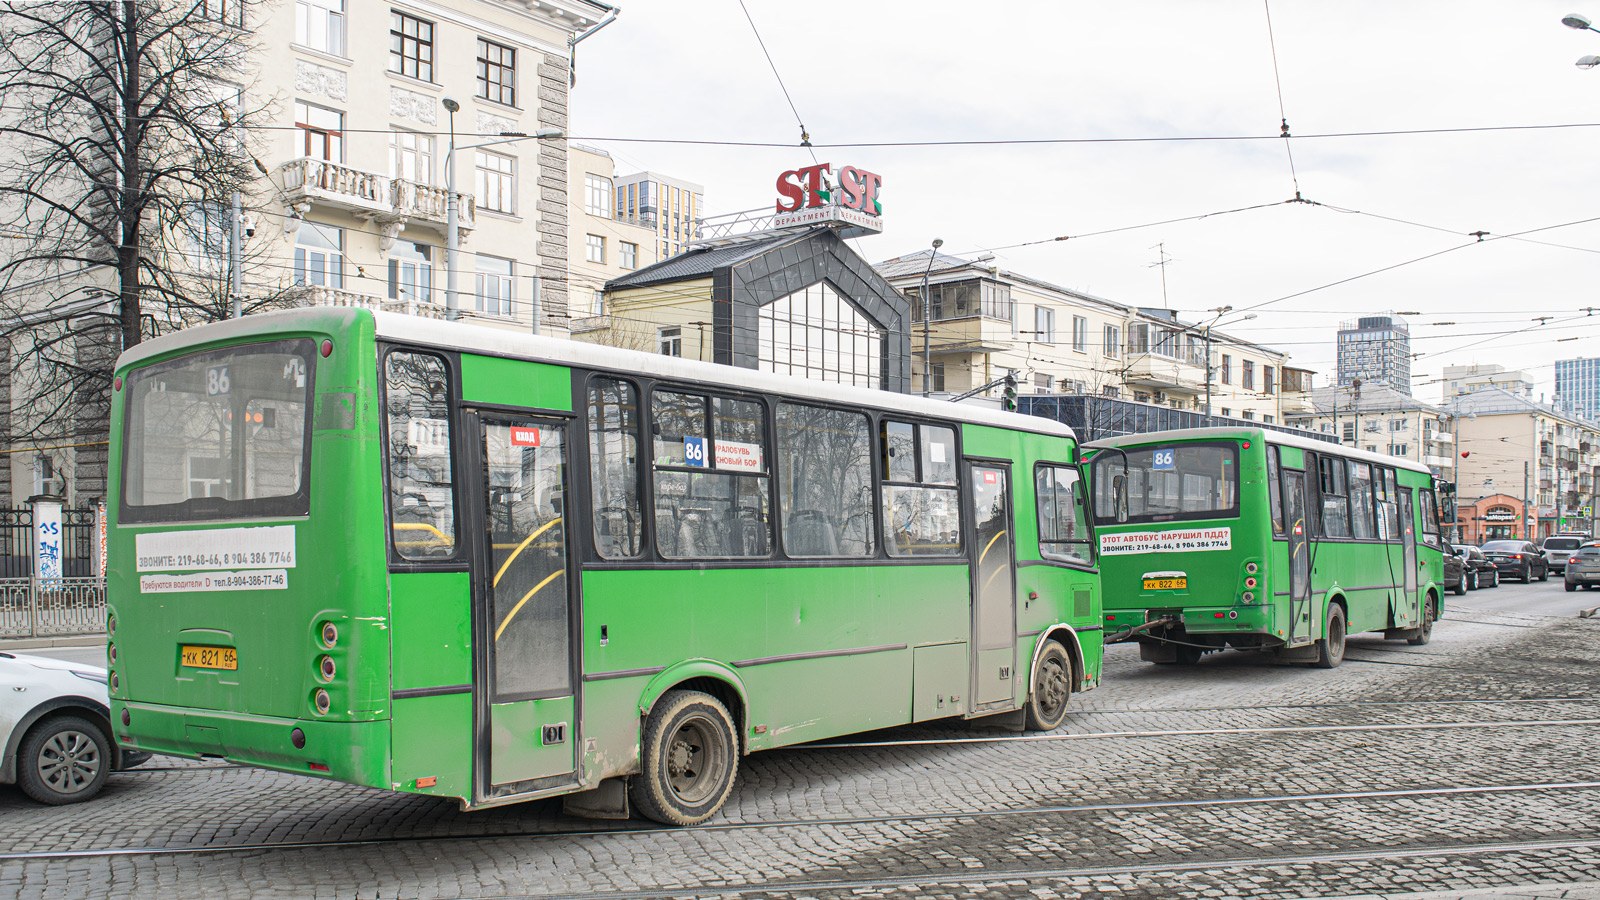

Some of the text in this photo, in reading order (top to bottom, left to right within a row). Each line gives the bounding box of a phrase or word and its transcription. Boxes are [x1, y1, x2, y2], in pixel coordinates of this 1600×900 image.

[776, 210, 830, 226] DEPARTMENT
[840, 210, 882, 228] DEPARTMENT
[208, 368, 230, 395] 86
[516, 431, 536, 444] ВХОД
[686, 442, 702, 460] 86
[744, 459, 758, 468] БОР
[1155, 452, 1172, 466] 86
[1102, 530, 1228, 544] ЭТОТ АВТОБУС НАРУШИЛ ПДД?
[1136, 543, 1174, 551] 219-68-66,
[139, 551, 292, 568] ЗВОНИТЕ: 219-68-66, 8 904 386 7746
[142, 580, 172, 592] Требуются
[173, 579, 202, 590] водители
[206, 578, 211, 587] D
[187, 649, 233, 666] КК 821 66
